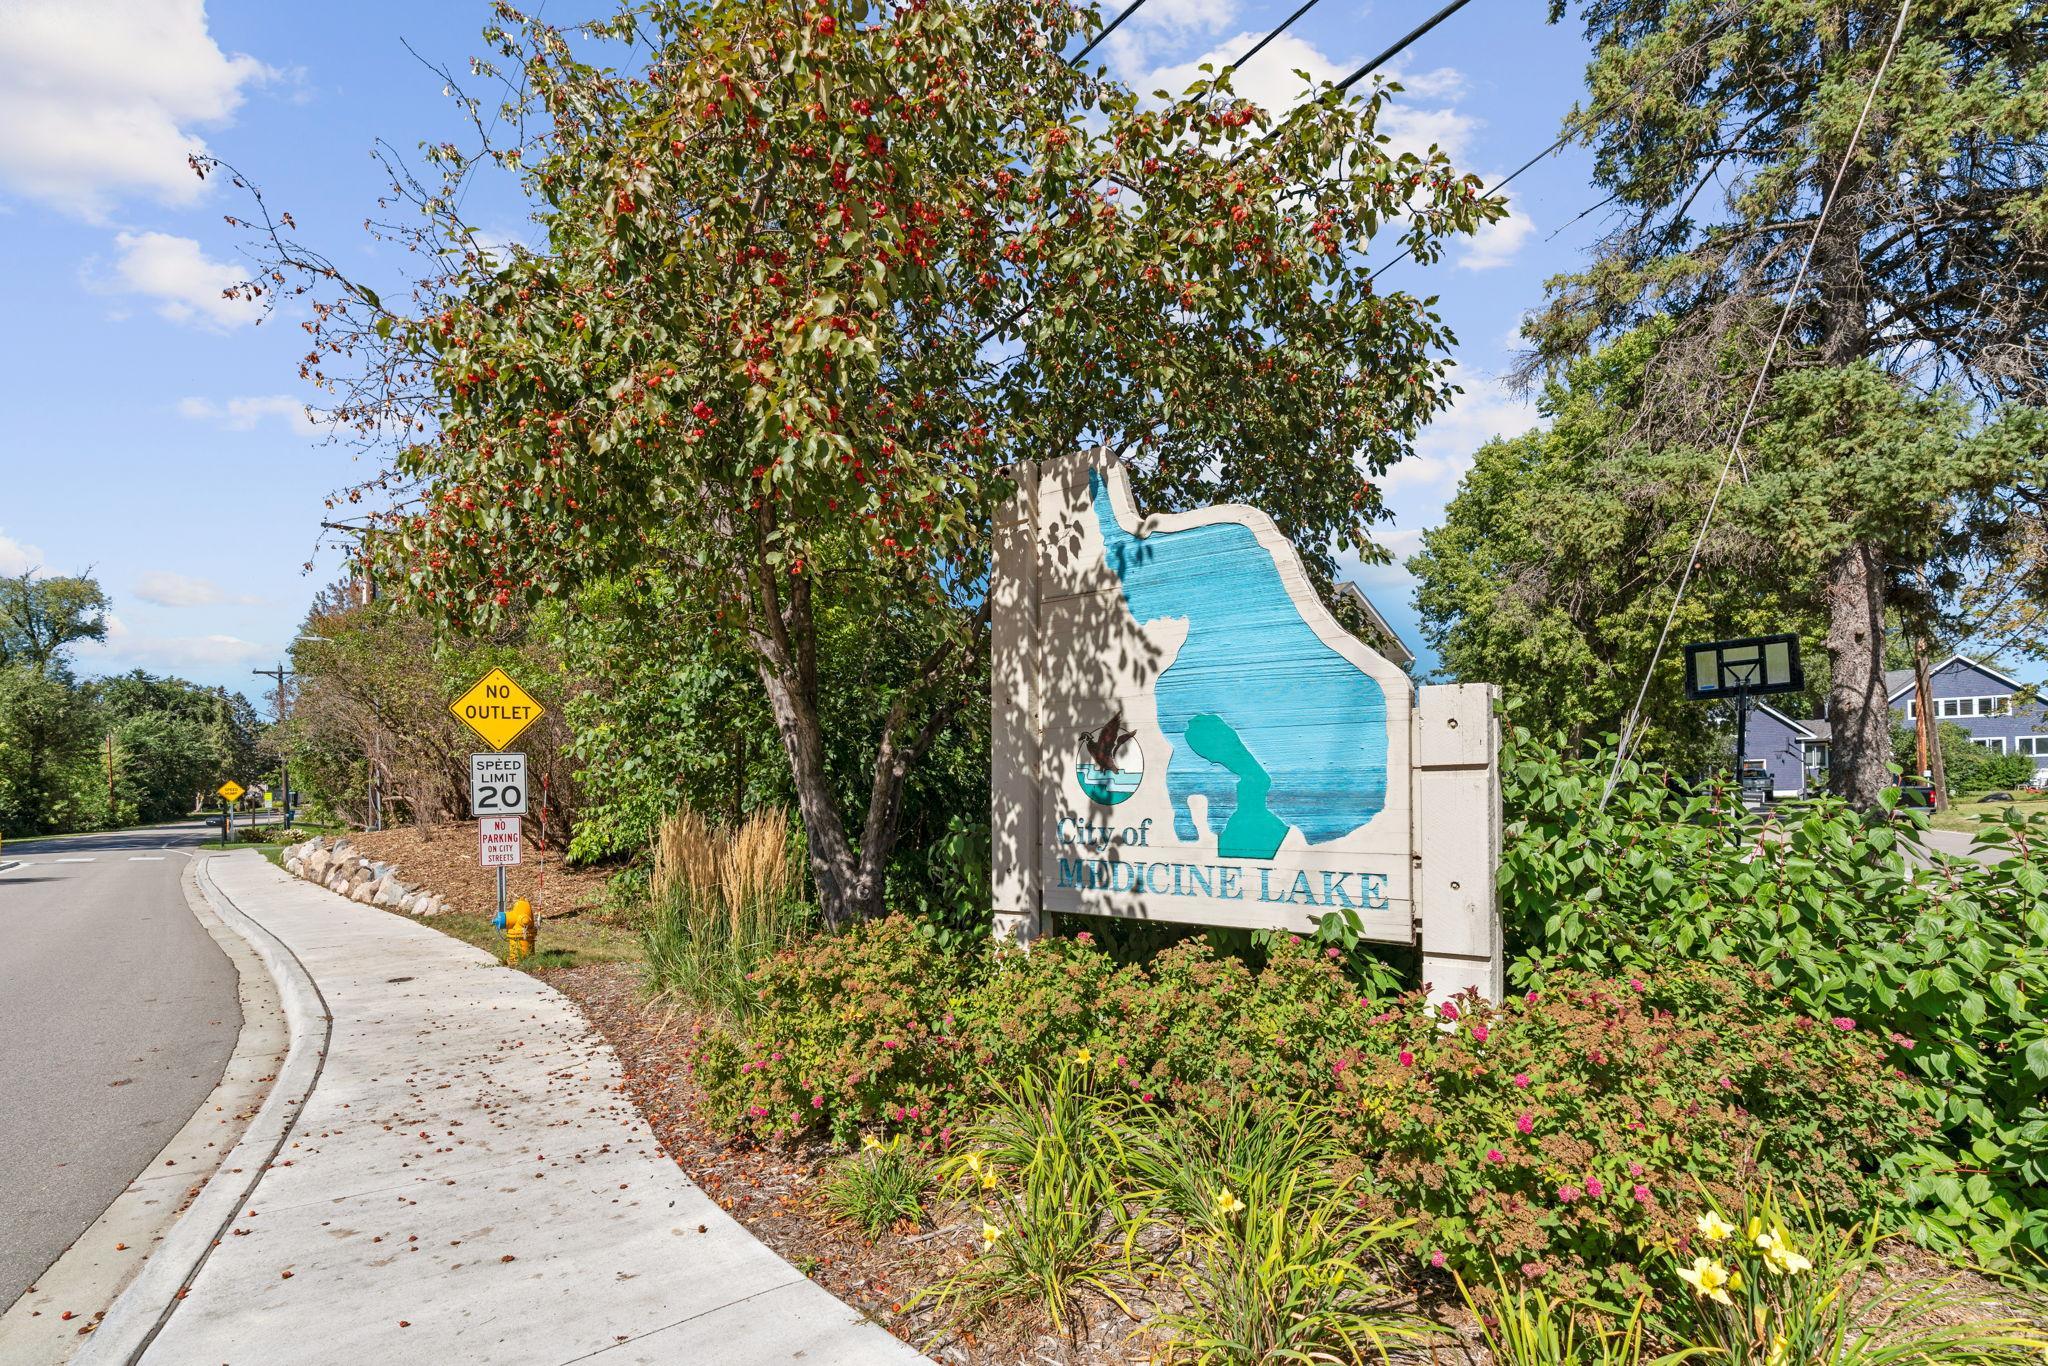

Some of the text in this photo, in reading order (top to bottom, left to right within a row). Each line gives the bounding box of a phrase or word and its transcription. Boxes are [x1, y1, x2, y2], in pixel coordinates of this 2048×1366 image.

[486, 685, 510, 699] NO
[465, 705, 531, 719] OUTLET
[476, 760, 521, 771] SPEED
[481, 773, 516, 783] LIMIT
[478, 785, 521, 808] 20
[494, 821, 506, 831] NO
[482, 832, 518, 844] PARKING
[1056, 817, 1153, 851] City of
[488, 844, 513, 853] ON CITY
[488, 854, 514, 862] STREETS
[1056, 857, 1389, 910] MEDICINE LAKE
